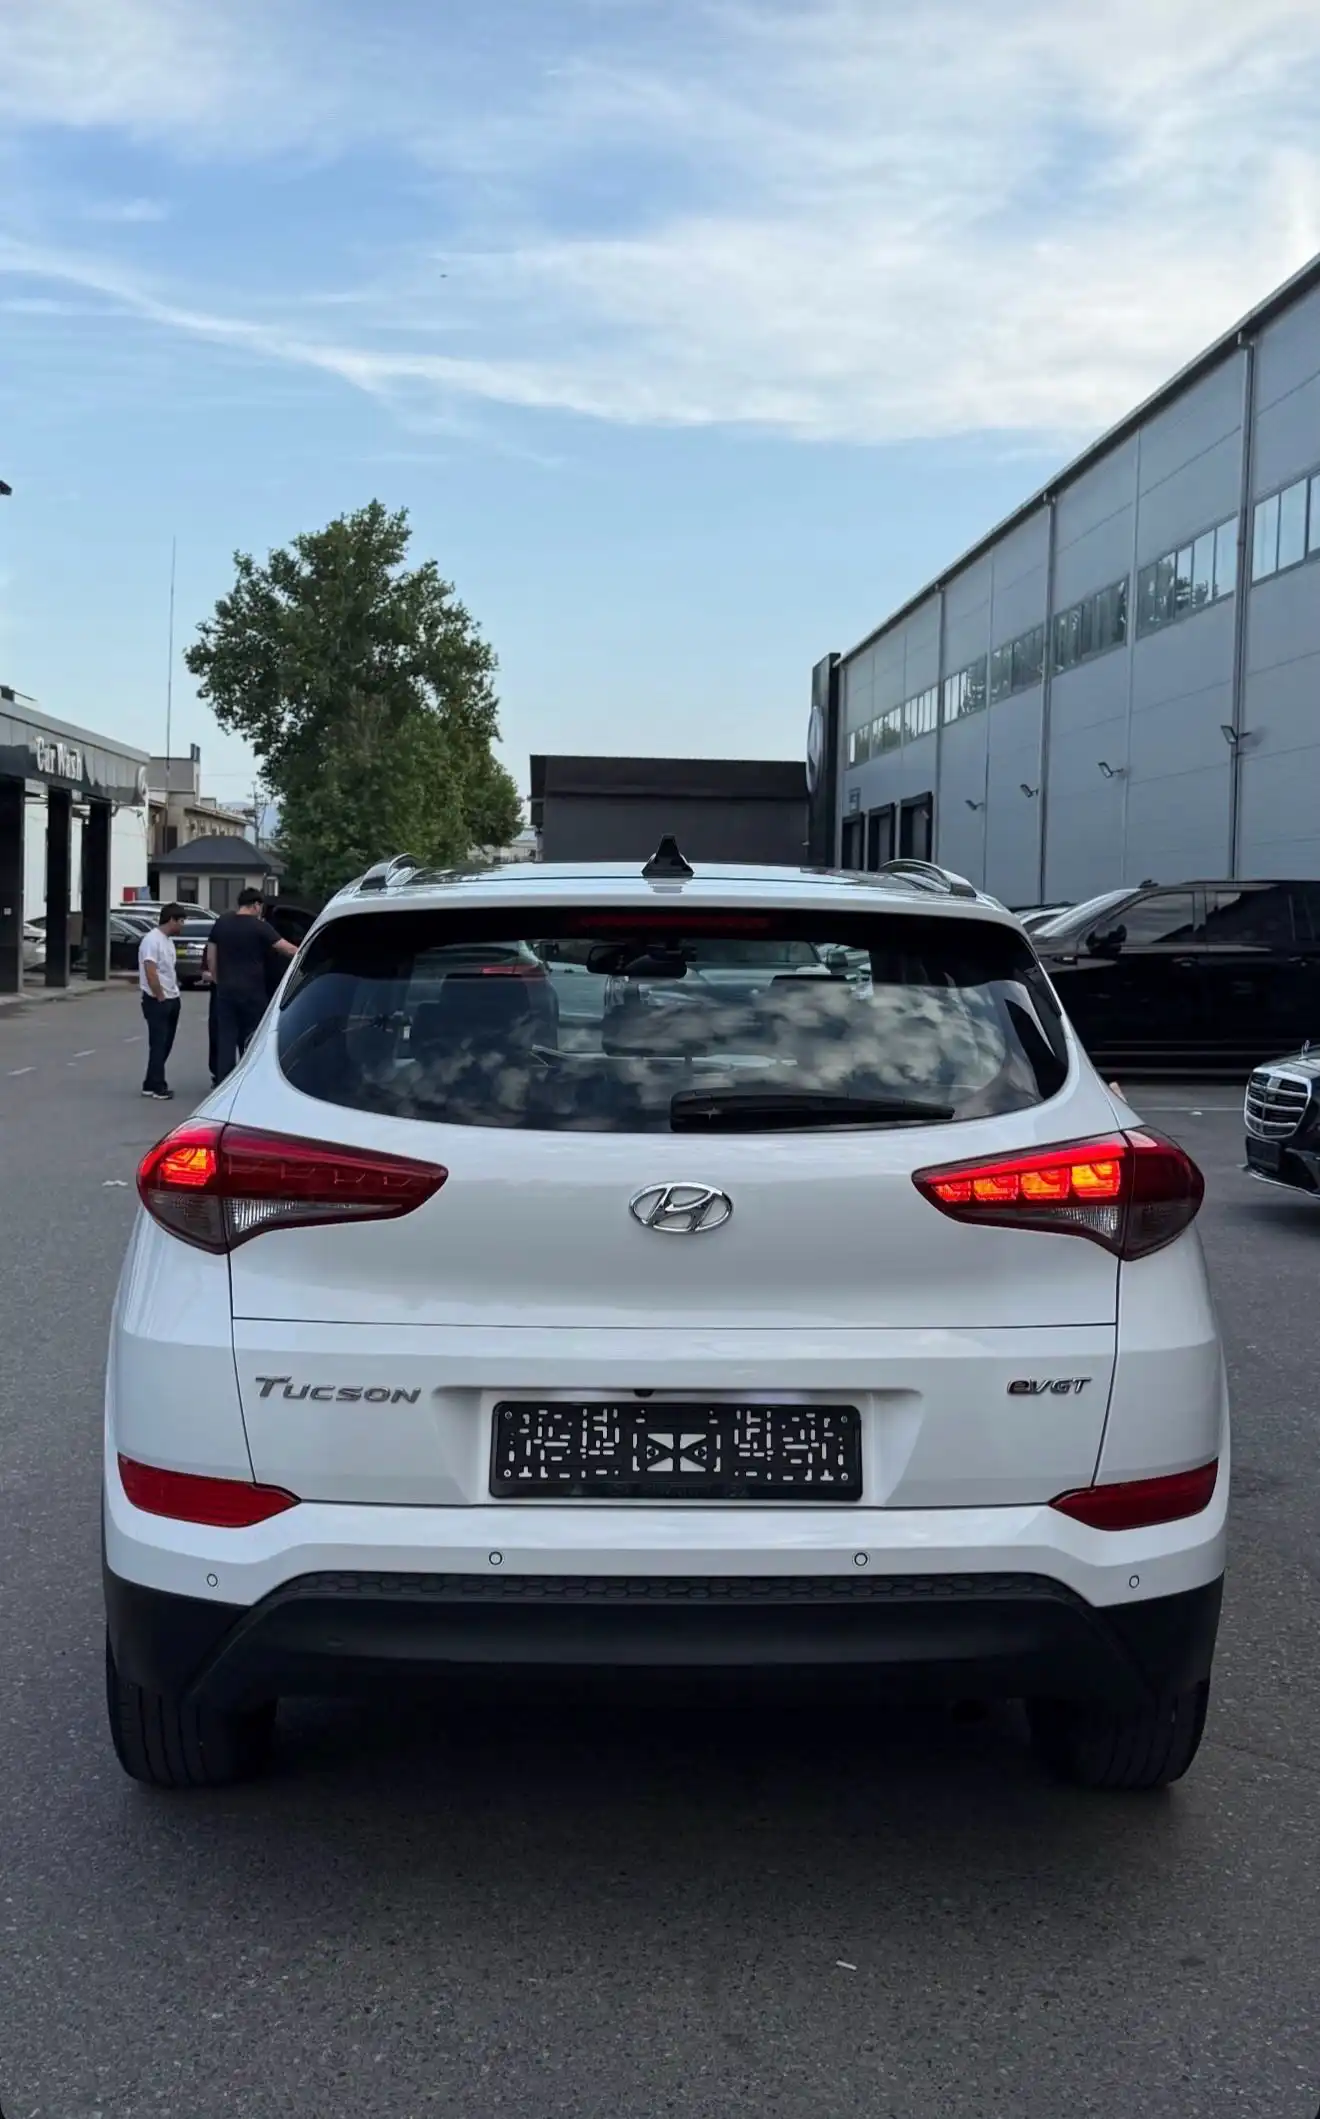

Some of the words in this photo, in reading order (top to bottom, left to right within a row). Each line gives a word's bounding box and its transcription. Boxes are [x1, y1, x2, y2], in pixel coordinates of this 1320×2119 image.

[36, 736, 56, 774] Car
[56, 742, 83, 782] Wash
[255, 1376, 421, 1404] TUCSON
